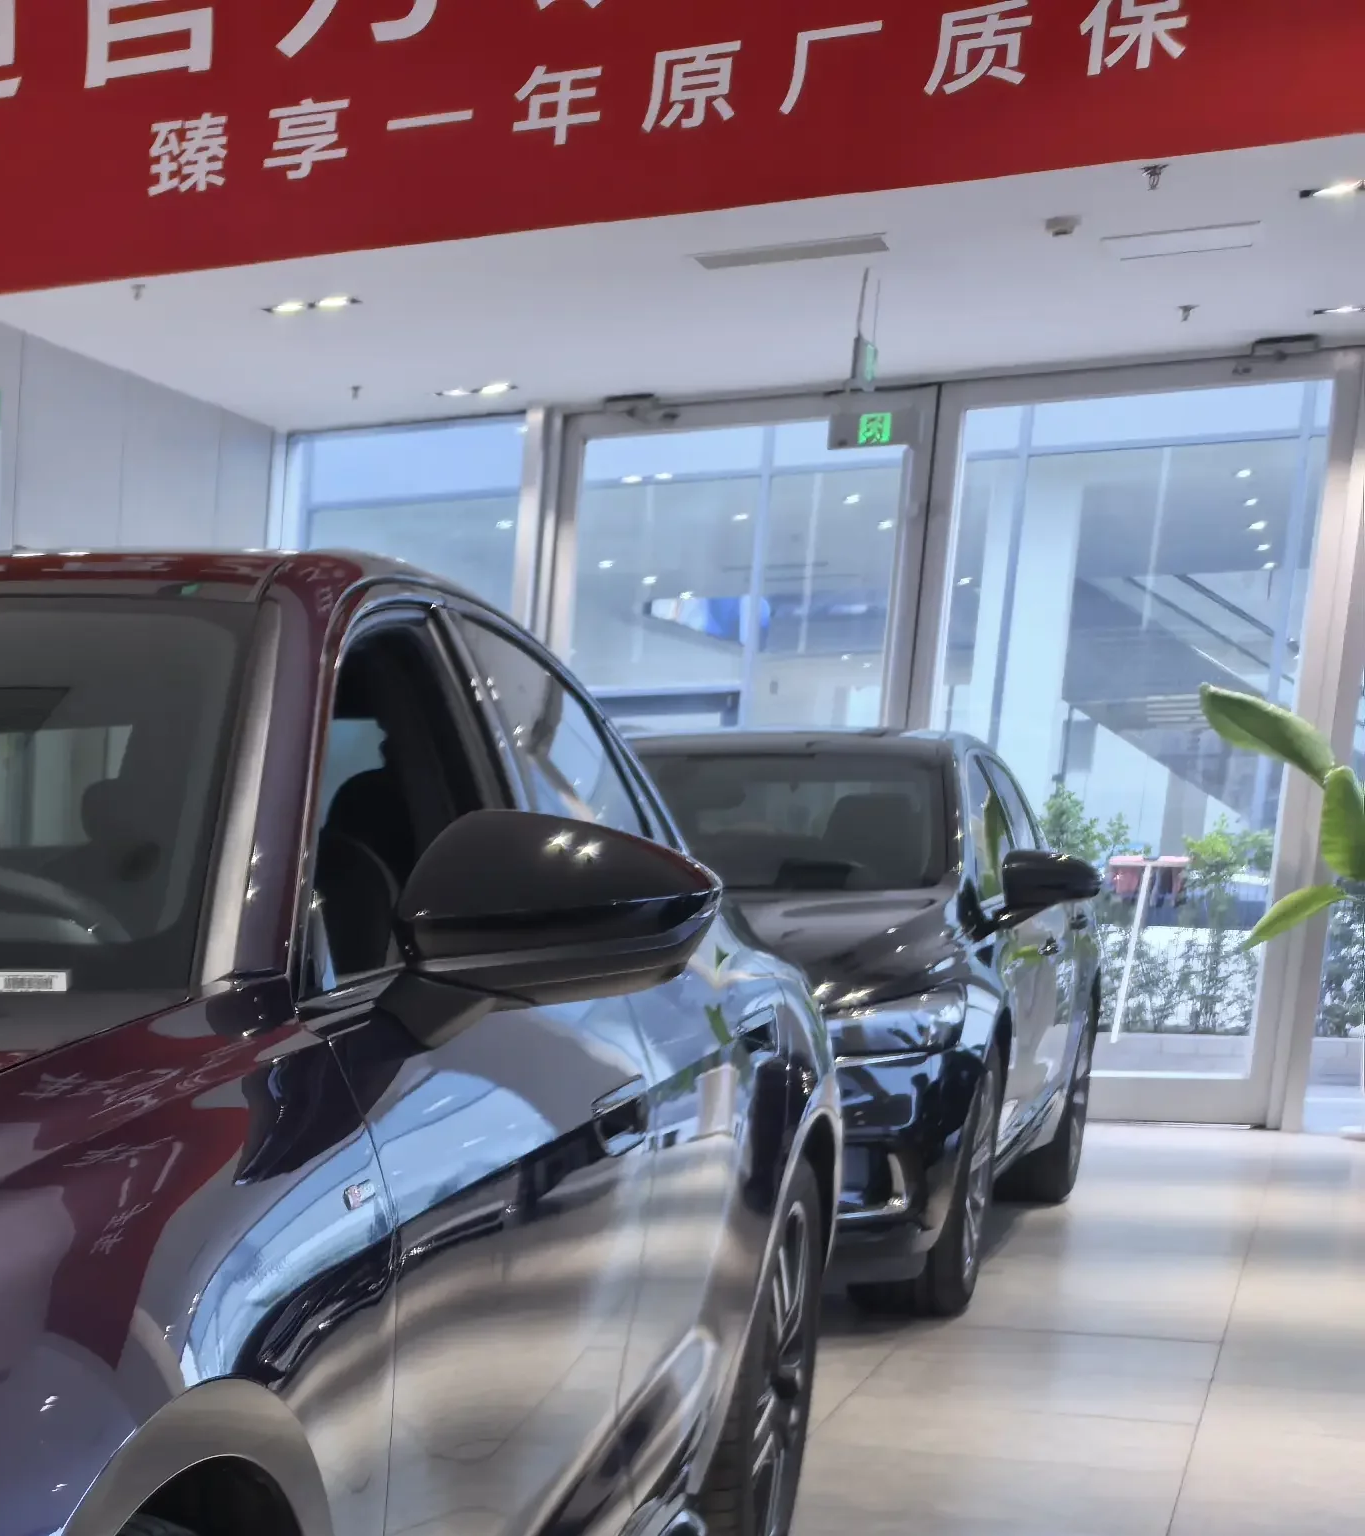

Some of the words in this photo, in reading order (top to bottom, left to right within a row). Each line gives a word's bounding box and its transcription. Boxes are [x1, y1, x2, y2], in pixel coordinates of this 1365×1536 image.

[146, 0, 1187, 197] 臻享一年原厂质保
